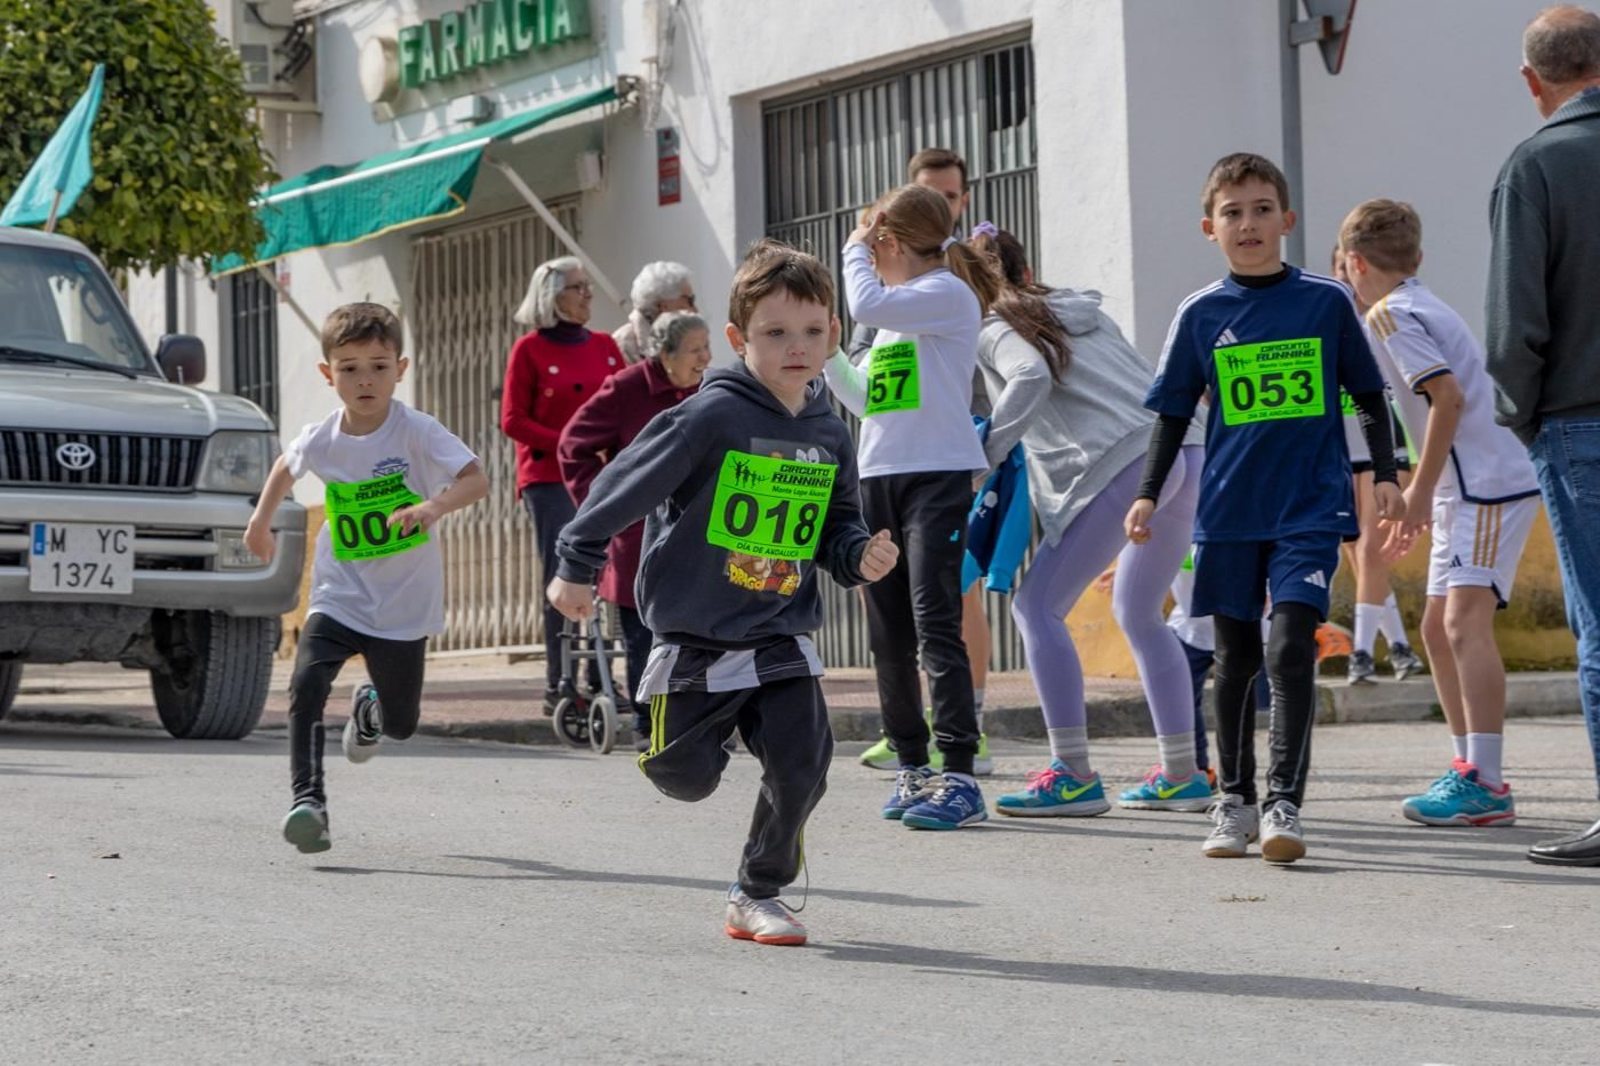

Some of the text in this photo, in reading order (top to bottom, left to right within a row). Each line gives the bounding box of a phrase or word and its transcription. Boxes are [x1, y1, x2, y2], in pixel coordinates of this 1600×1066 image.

[399, 0, 574, 88] FARMACIA
[1256, 348, 1316, 362] RUNNING
[1260, 342, 1311, 352] CIRCUITO
[866, 368, 912, 404] 57
[1230, 369, 1315, 411] 053
[780, 464, 831, 477] CIRCUITO
[358, 475, 403, 491] CIRCUIT
[771, 473, 832, 489] RUNNING
[771, 485, 792, 494] Monte
[723, 492, 821, 546] 018
[51, 527, 66, 553] M
[752, 545, 764, 554] DE
[52, 561, 115, 589] 1374
